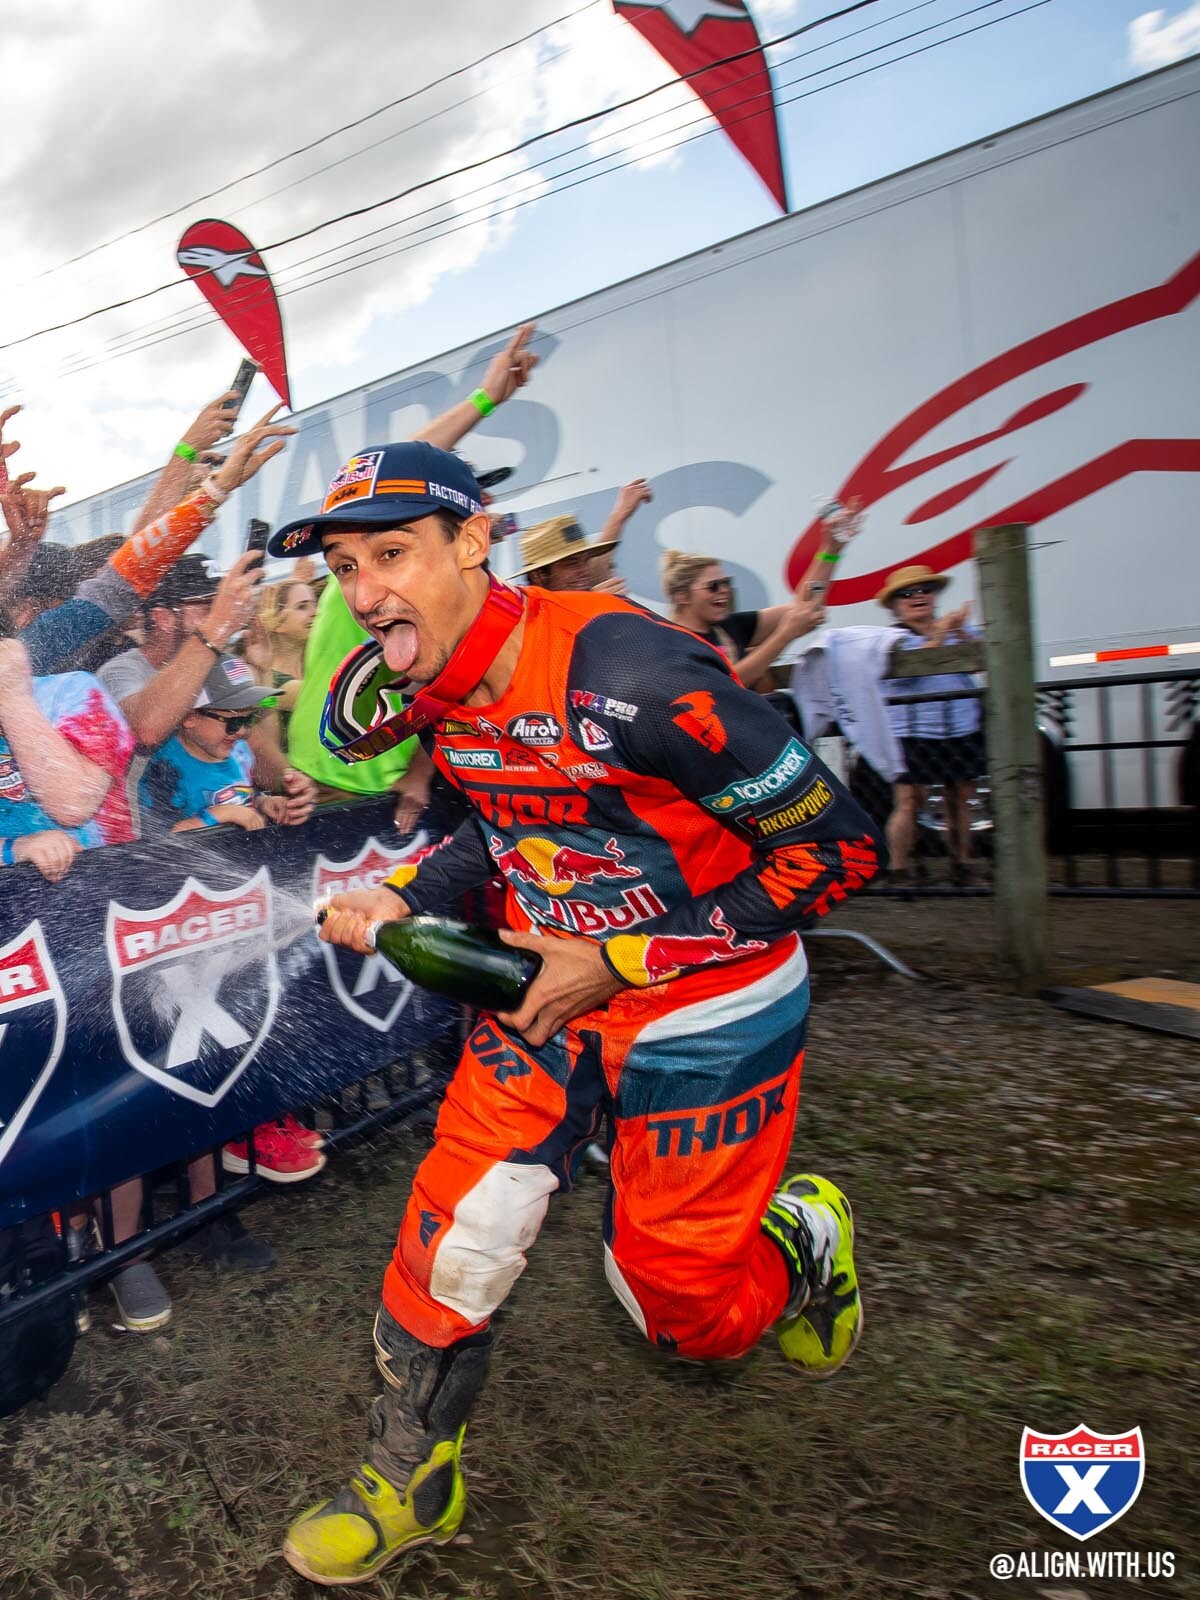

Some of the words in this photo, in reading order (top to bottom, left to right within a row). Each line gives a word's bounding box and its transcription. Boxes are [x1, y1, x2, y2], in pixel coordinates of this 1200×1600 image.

[429, 481, 470, 509] FACTORY
[511, 718, 560, 737] Airoh
[449, 751, 497, 767] MOTOREX
[123, 903, 265, 960] RACER
[567, 883, 668, 934] Bull
[159, 954, 252, 1069] X
[646, 1079, 787, 1158] THOR
